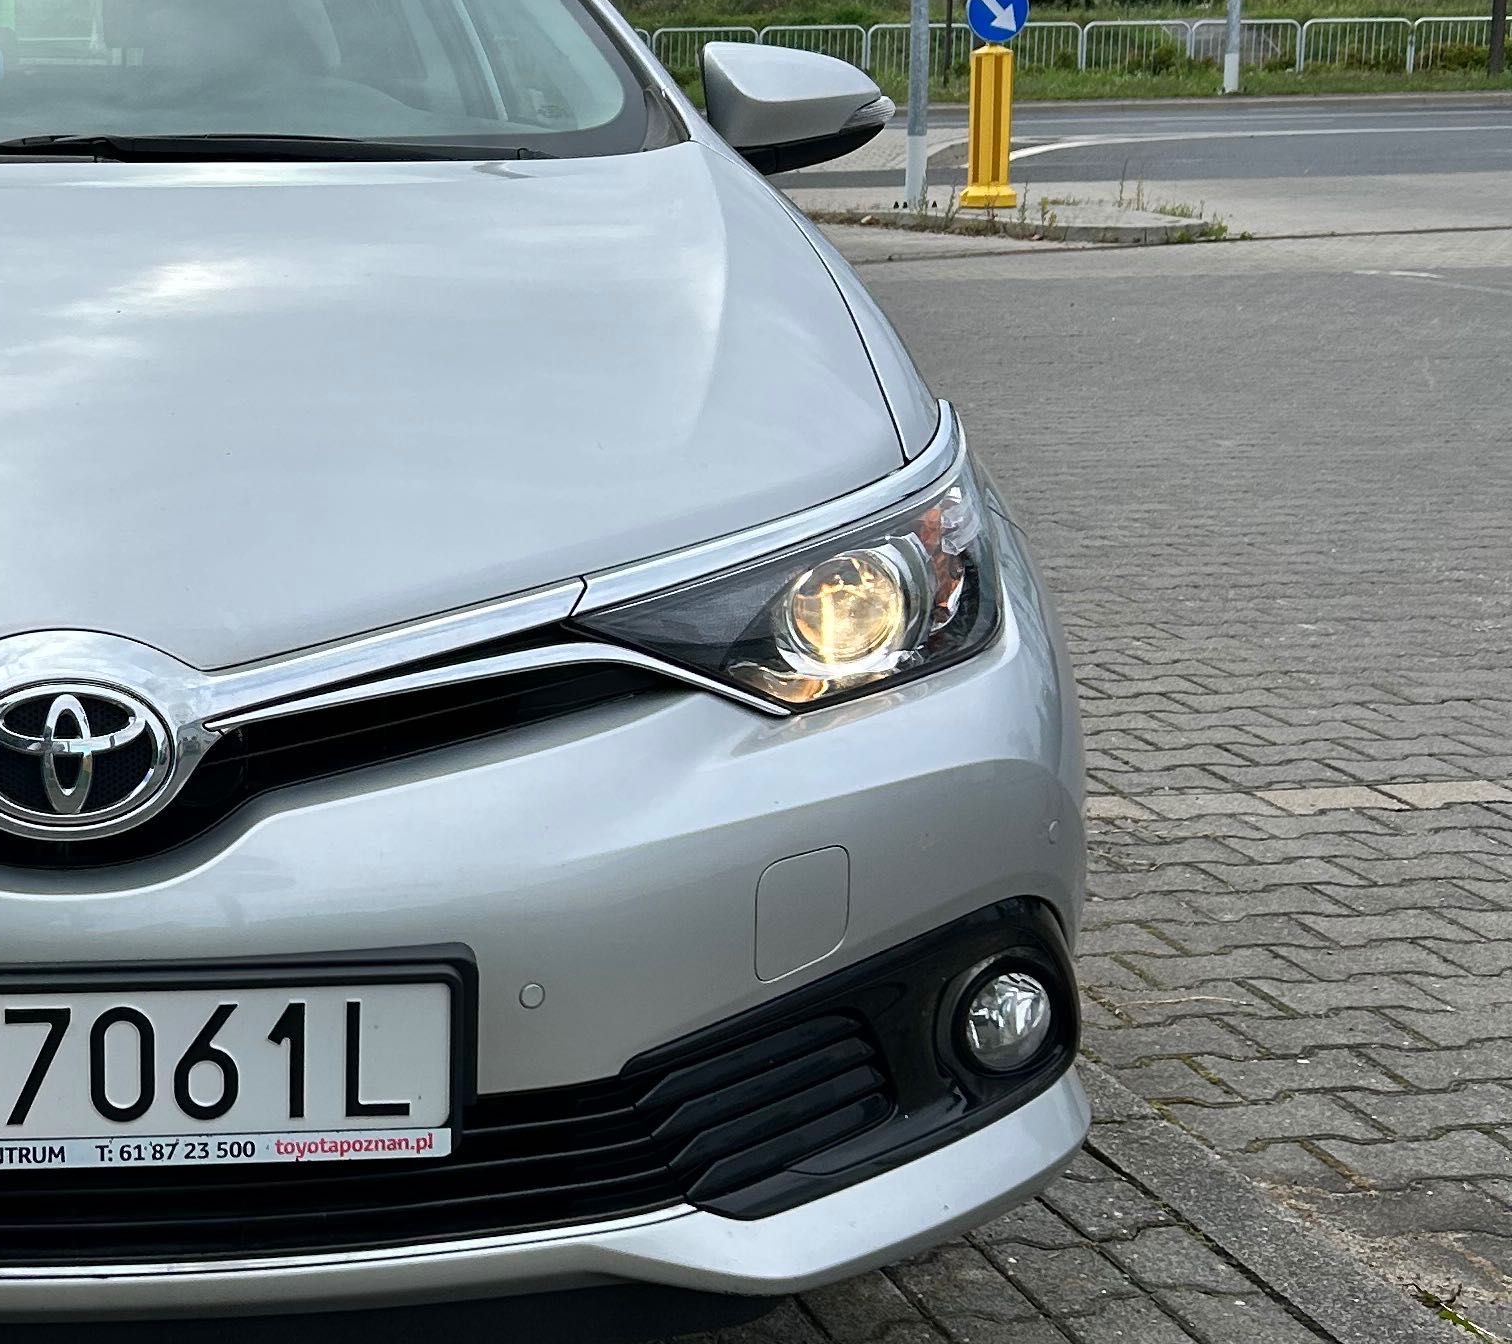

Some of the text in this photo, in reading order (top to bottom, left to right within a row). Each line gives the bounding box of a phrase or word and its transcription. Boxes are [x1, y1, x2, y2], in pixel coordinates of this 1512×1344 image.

[4, 1000, 413, 1126] 7061L
[94, 1144, 114, 1162] T:
[119, 1144, 147, 1162] 61
[151, 1142, 179, 1161] 87
[183, 1142, 210, 1160] 23
[216, 1140, 256, 1159] 500
[274, 1133, 435, 1158] toyotapoznan.pl
